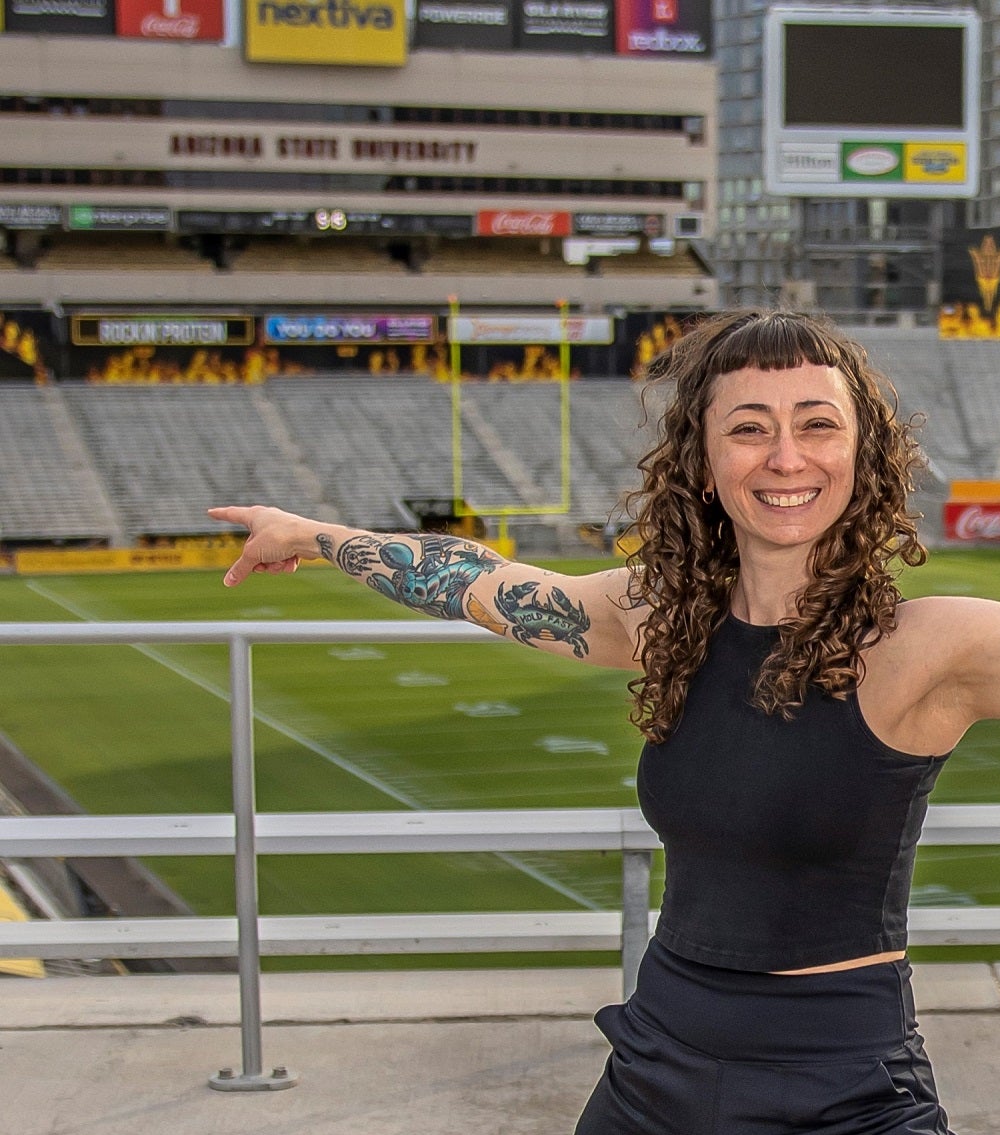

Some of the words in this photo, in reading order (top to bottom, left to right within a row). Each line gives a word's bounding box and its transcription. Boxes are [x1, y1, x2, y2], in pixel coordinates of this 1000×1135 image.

[258, 0, 395, 30] nextiva
[170, 134, 263, 159] ARIZONA
[276, 137, 338, 161] STATE
[352, 138, 478, 162] UNIVERSITY
[519, 612, 543, 625] HOLD
[547, 613, 576, 629] FAST
